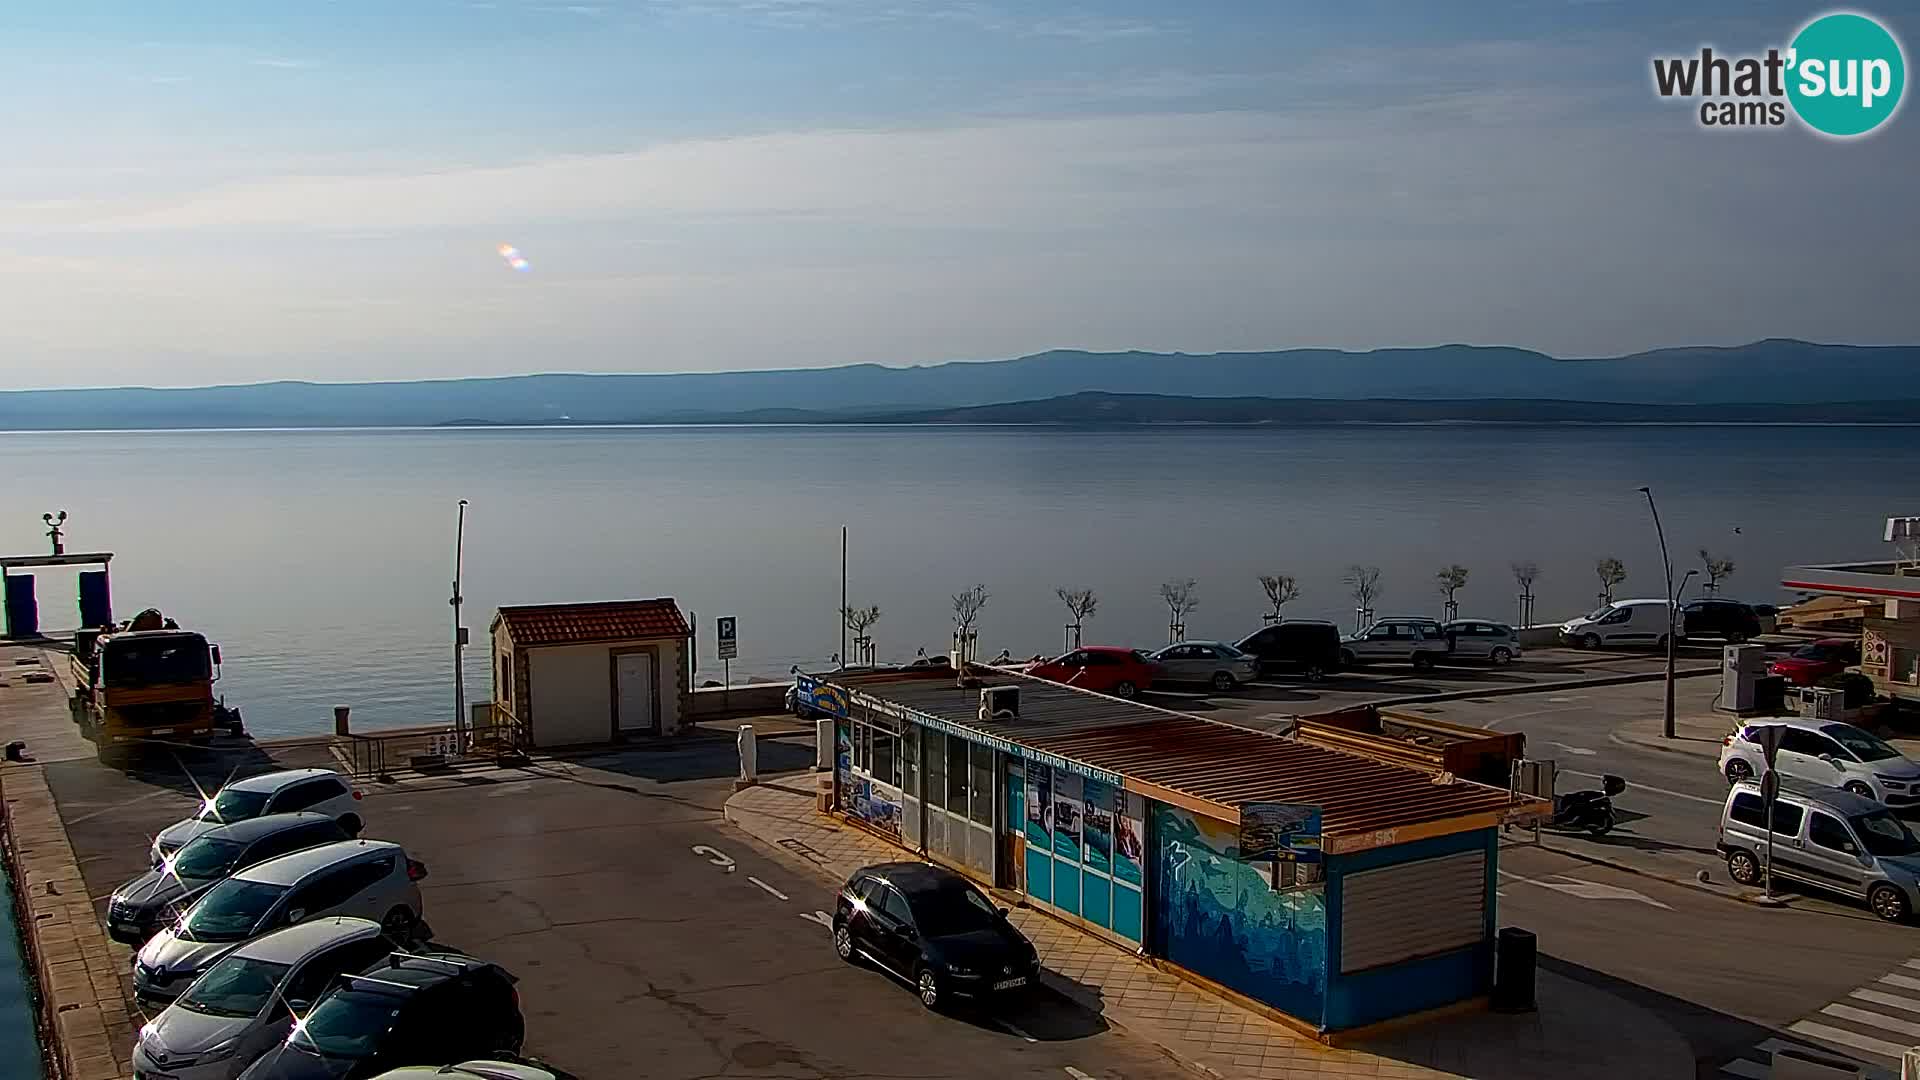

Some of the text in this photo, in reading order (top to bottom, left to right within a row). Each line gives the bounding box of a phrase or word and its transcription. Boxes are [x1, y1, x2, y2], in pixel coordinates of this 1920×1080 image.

[722, 620, 732, 637] P
[946, 724, 982, 743] AUTOBUSNA
[983, 736, 1012, 752] POSTAJA
[1021, 746, 1035, 759] BUS
[1035, 751, 1066, 769] STATION
[1067, 761, 1092, 777] TICKET
[1093, 769, 1119, 785] OFFICE
